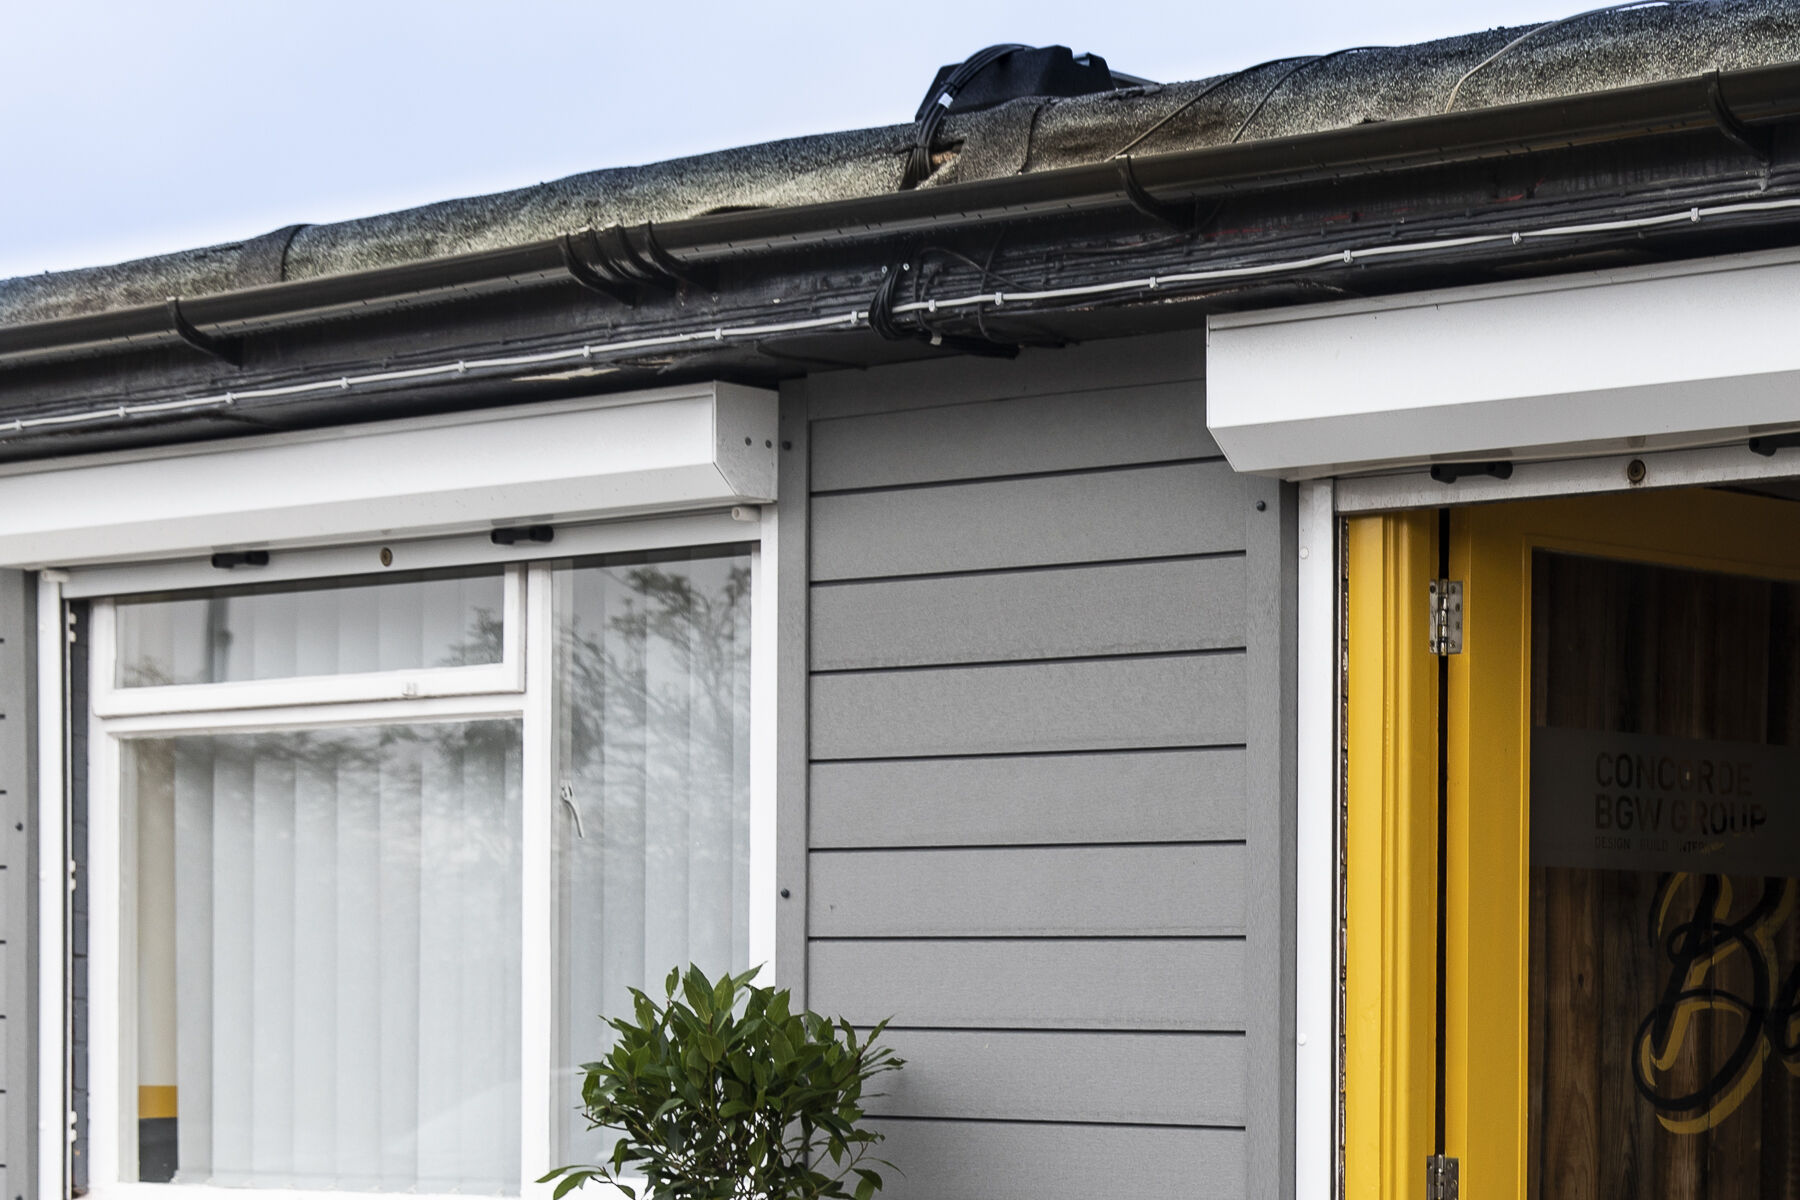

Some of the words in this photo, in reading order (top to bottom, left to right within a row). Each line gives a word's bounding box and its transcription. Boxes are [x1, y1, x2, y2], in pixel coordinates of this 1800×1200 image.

[1594, 751, 1754, 797] CONCORDE
[1594, 793, 1664, 832] BGW
[1670, 799, 1768, 836] GROUP
